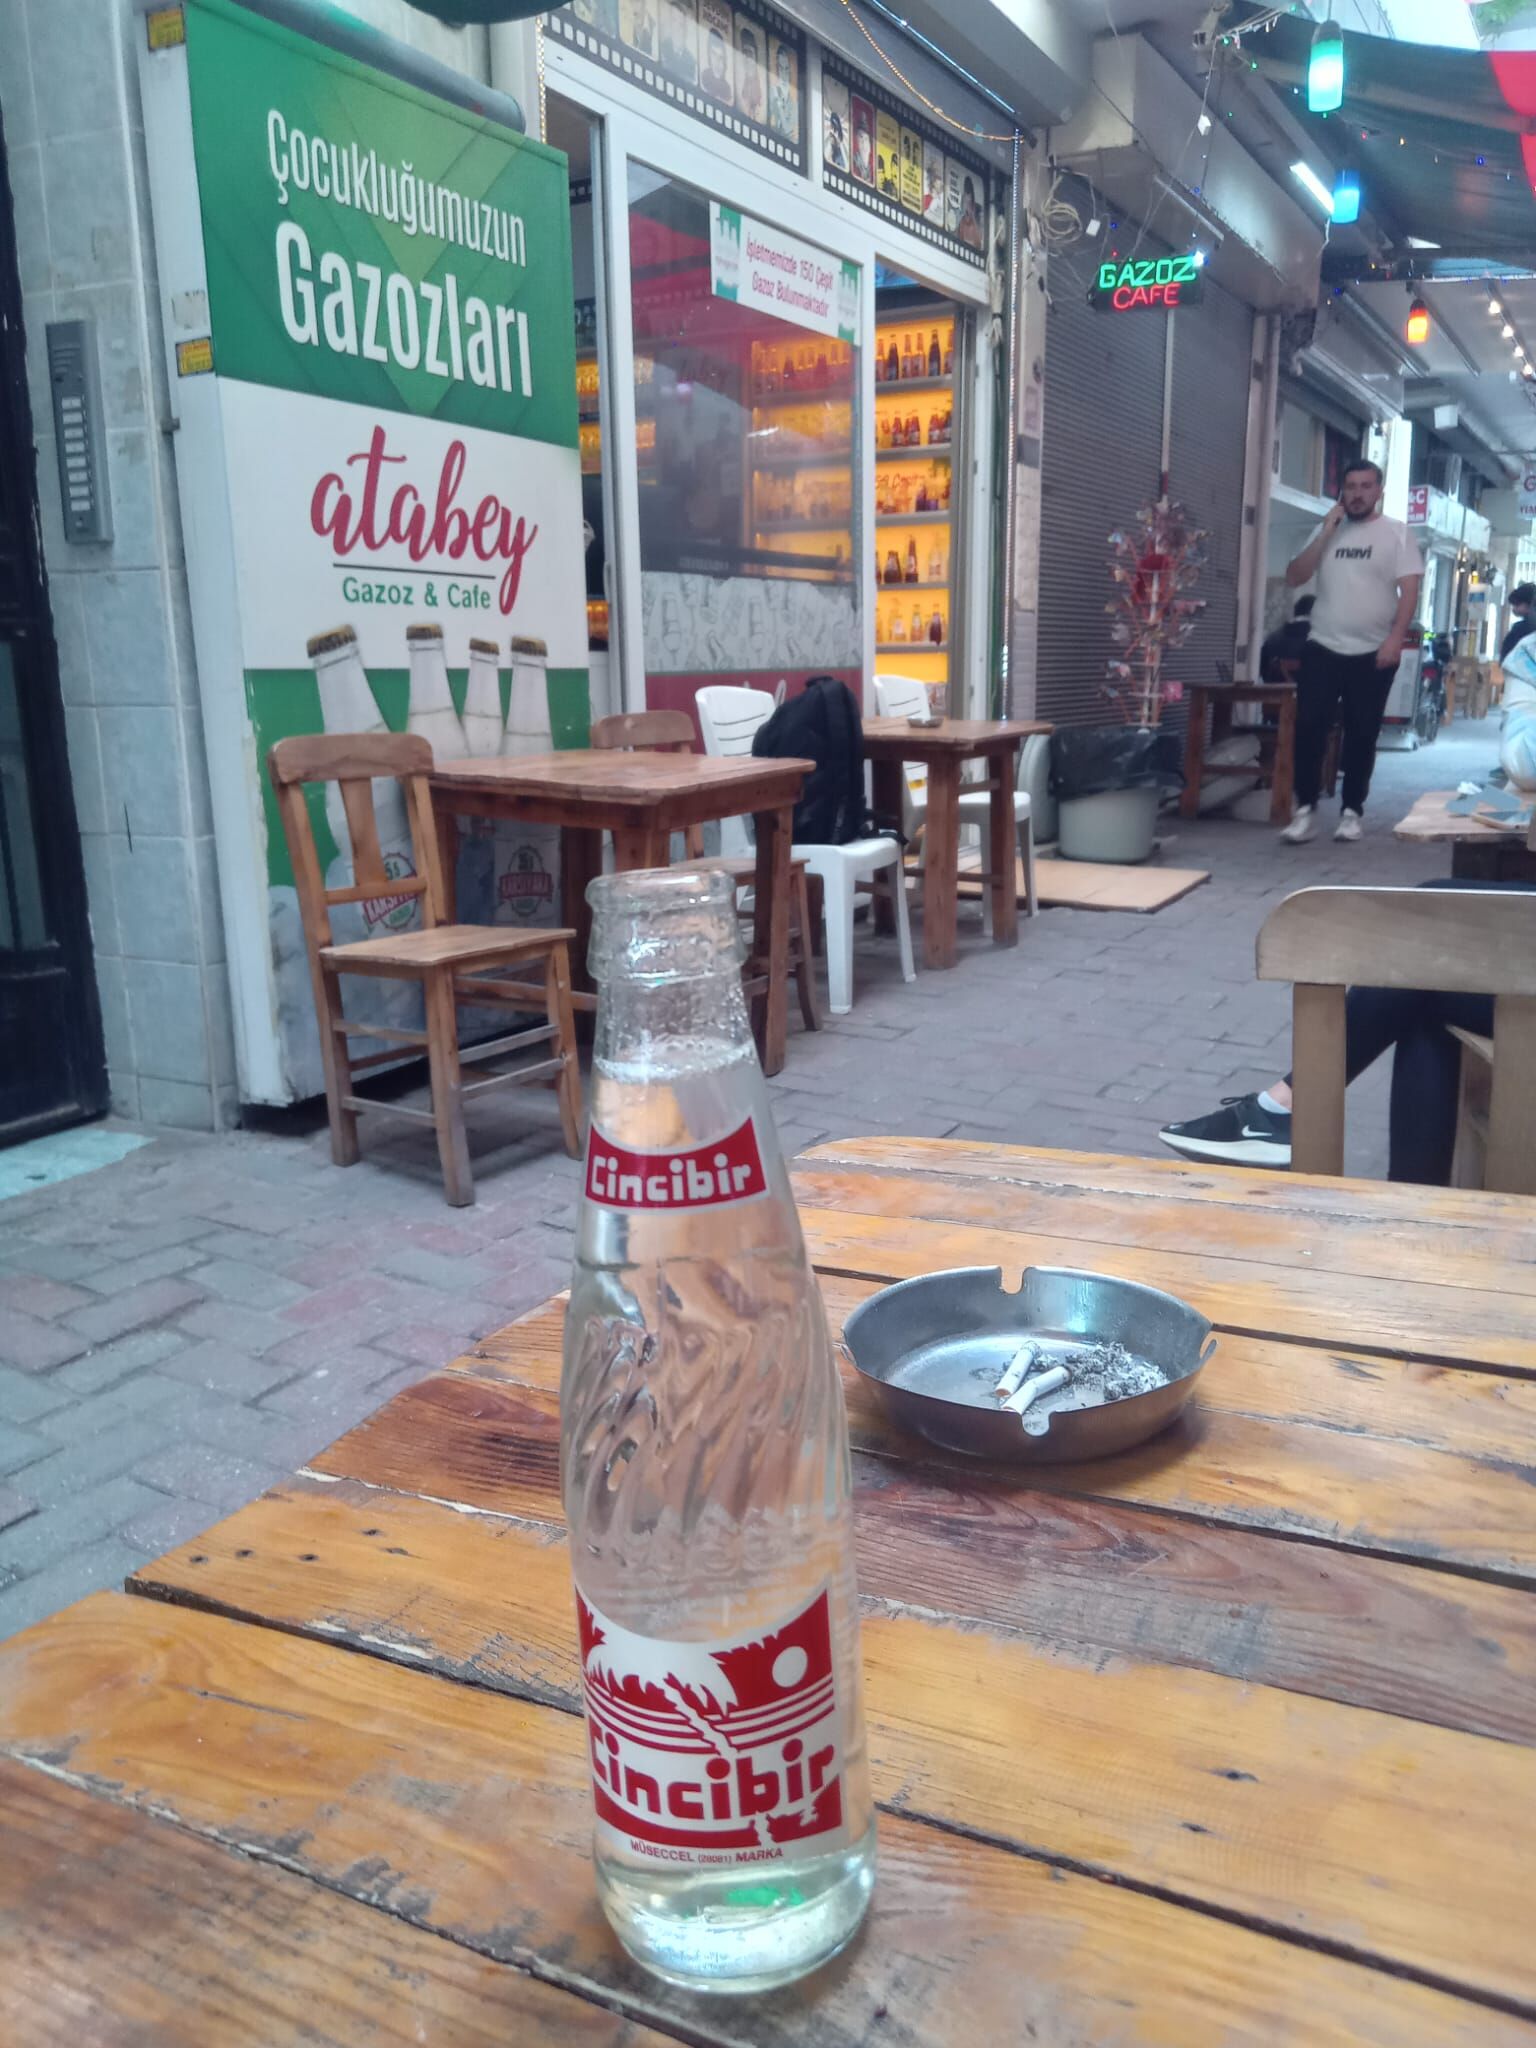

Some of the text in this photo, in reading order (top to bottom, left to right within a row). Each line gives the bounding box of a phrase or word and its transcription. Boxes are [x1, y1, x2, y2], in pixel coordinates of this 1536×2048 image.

[267, 109, 526, 267] Çocukluğumuzun
[800, 259, 814, 282] 150
[1099, 256, 1196, 288] GAZOZ
[276, 220, 532, 397] Gazozları
[1112, 282, 1181, 310] CAFE
[310, 424, 538, 615] atabey
[1335, 545, 1372, 560] mavi
[342, 576, 491, 609] Gazoz & Cafe
[630, 1839, 695, 1863] MÜSECCEL
[735, 1847, 783, 1863] MARKA
